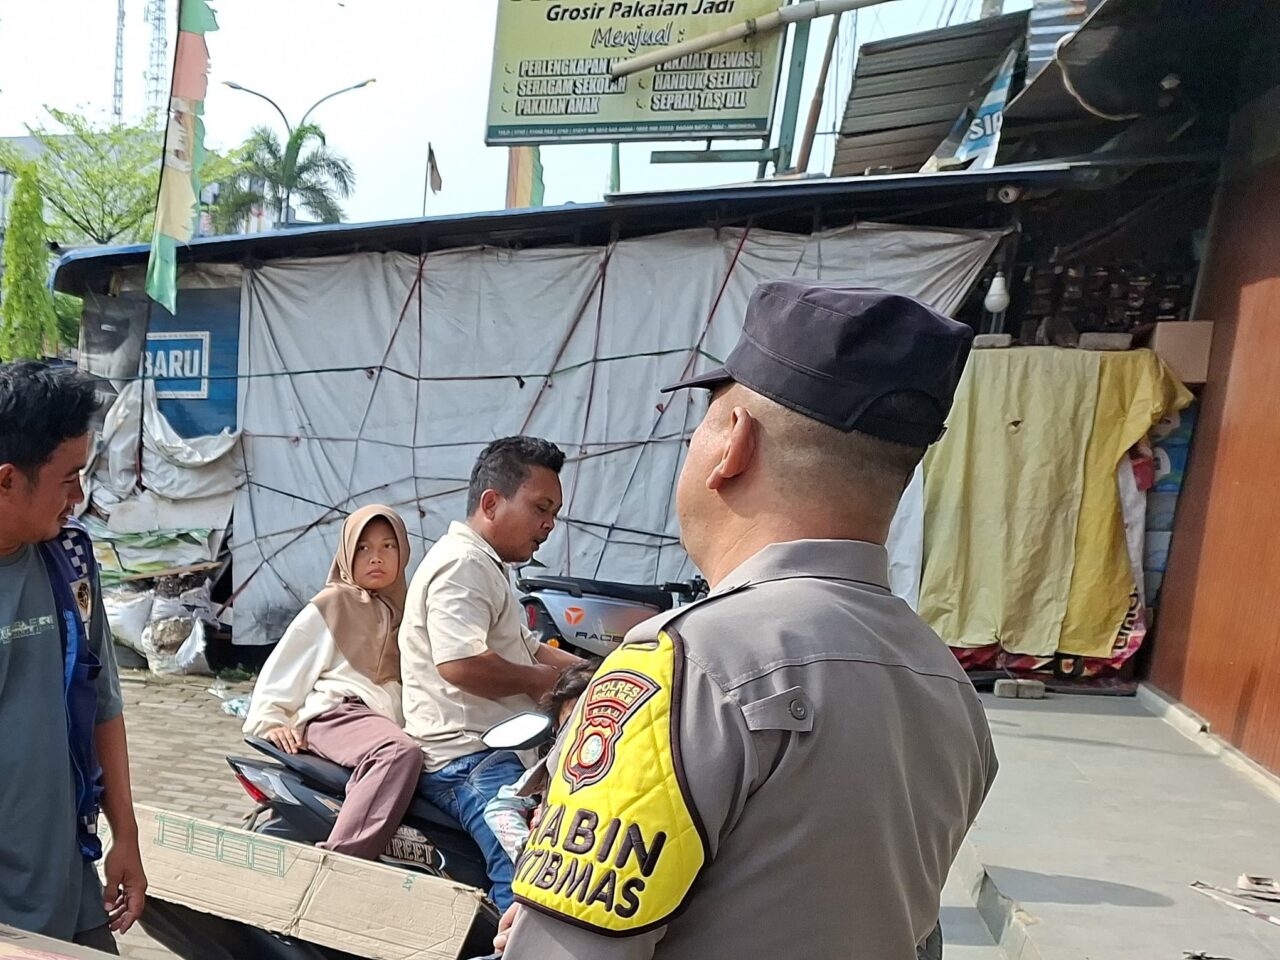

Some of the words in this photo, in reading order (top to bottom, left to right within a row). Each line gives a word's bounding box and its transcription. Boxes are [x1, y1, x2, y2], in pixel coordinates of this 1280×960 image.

[546, 3, 605, 21] Grosir
[609, 1, 687, 19] Pakaian
[692, 0, 734, 15] Jadi
[591, 23, 673, 53] Menjual
[519, 58, 607, 77] PERLENGKAPAN
[655, 52, 708, 71] AKAIAN
[709, 50, 762, 69] DEWASA
[707, 71, 761, 89] SELIMUT
[515, 99, 565, 116] PAKAIAN
[565, 97, 600, 114] ANAK
[139, 349, 200, 378] BARU
[593, 681, 640, 698] POLRES
